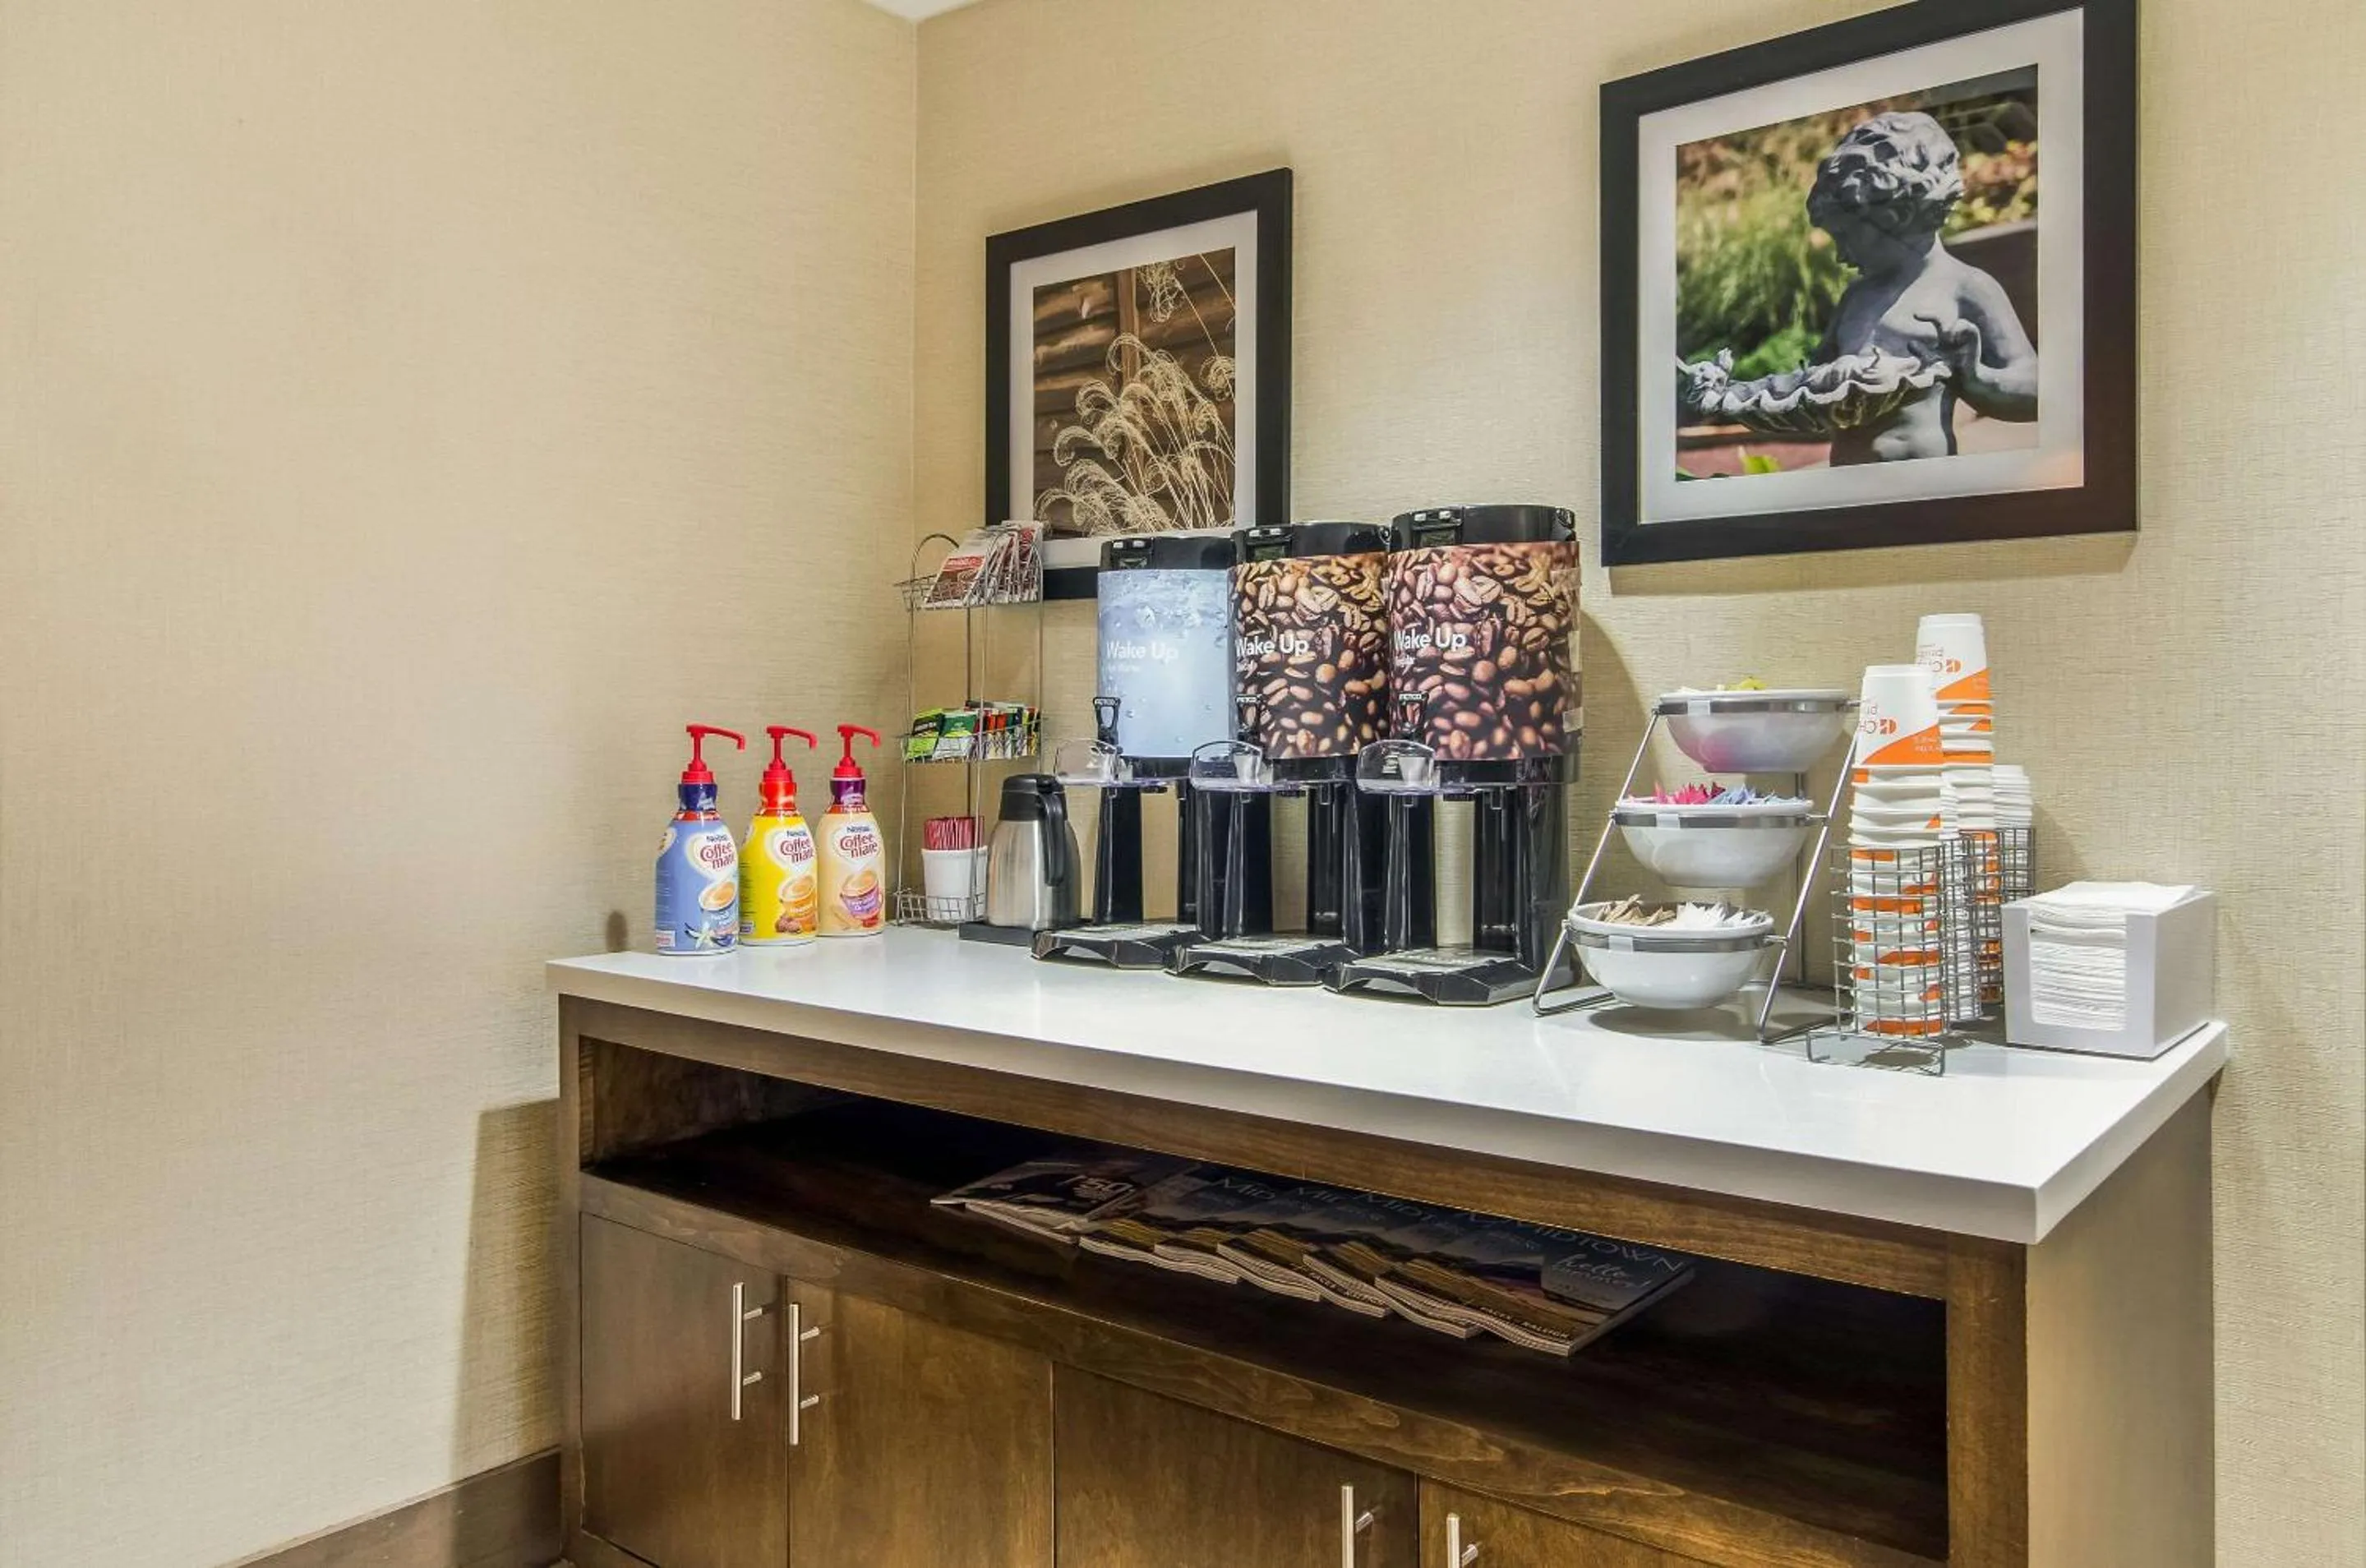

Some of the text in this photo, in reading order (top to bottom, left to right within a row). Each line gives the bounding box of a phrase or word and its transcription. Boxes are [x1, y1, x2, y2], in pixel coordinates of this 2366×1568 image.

[1280, 634, 1309, 656] Up
[1394, 627, 1467, 652] Wake Up
[1106, 640, 1179, 663] Wake Up
[780, 837, 811, 855] Coffee
[840, 833, 874, 851] Coffee
[699, 843, 732, 862] Coffee
